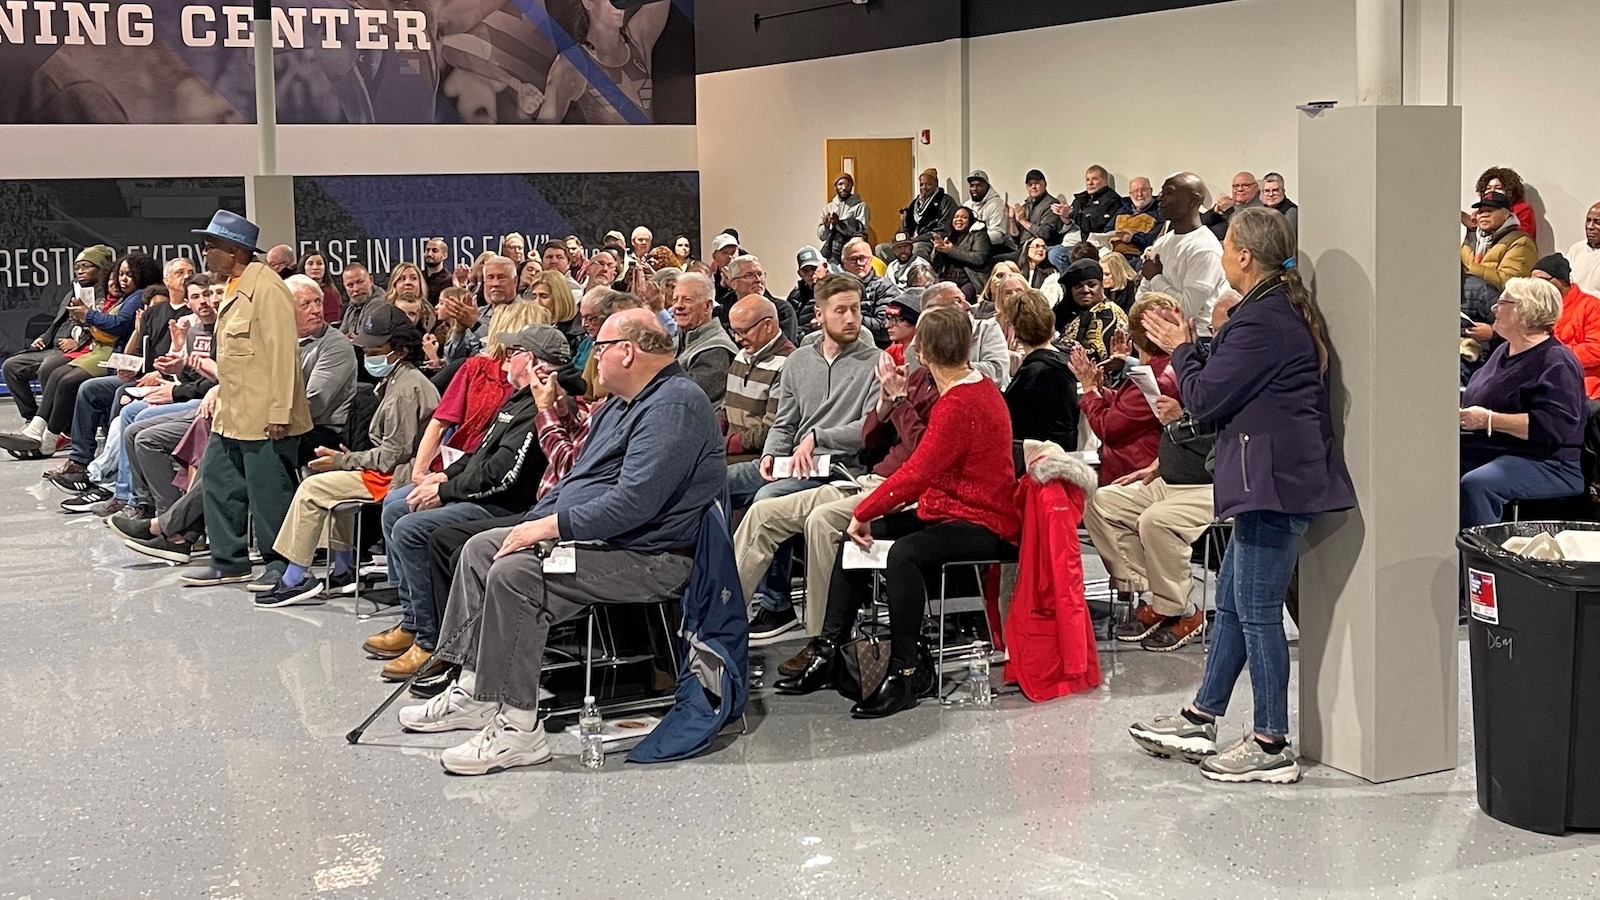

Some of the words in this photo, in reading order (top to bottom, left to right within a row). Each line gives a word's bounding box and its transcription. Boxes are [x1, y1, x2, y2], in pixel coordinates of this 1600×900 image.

[181, 5, 431, 50] CENTER
[300, 239, 357, 276] SE
[366, 238, 390, 273] IN
[399, 237, 444, 271] LIF
[453, 235, 475, 268] IS
